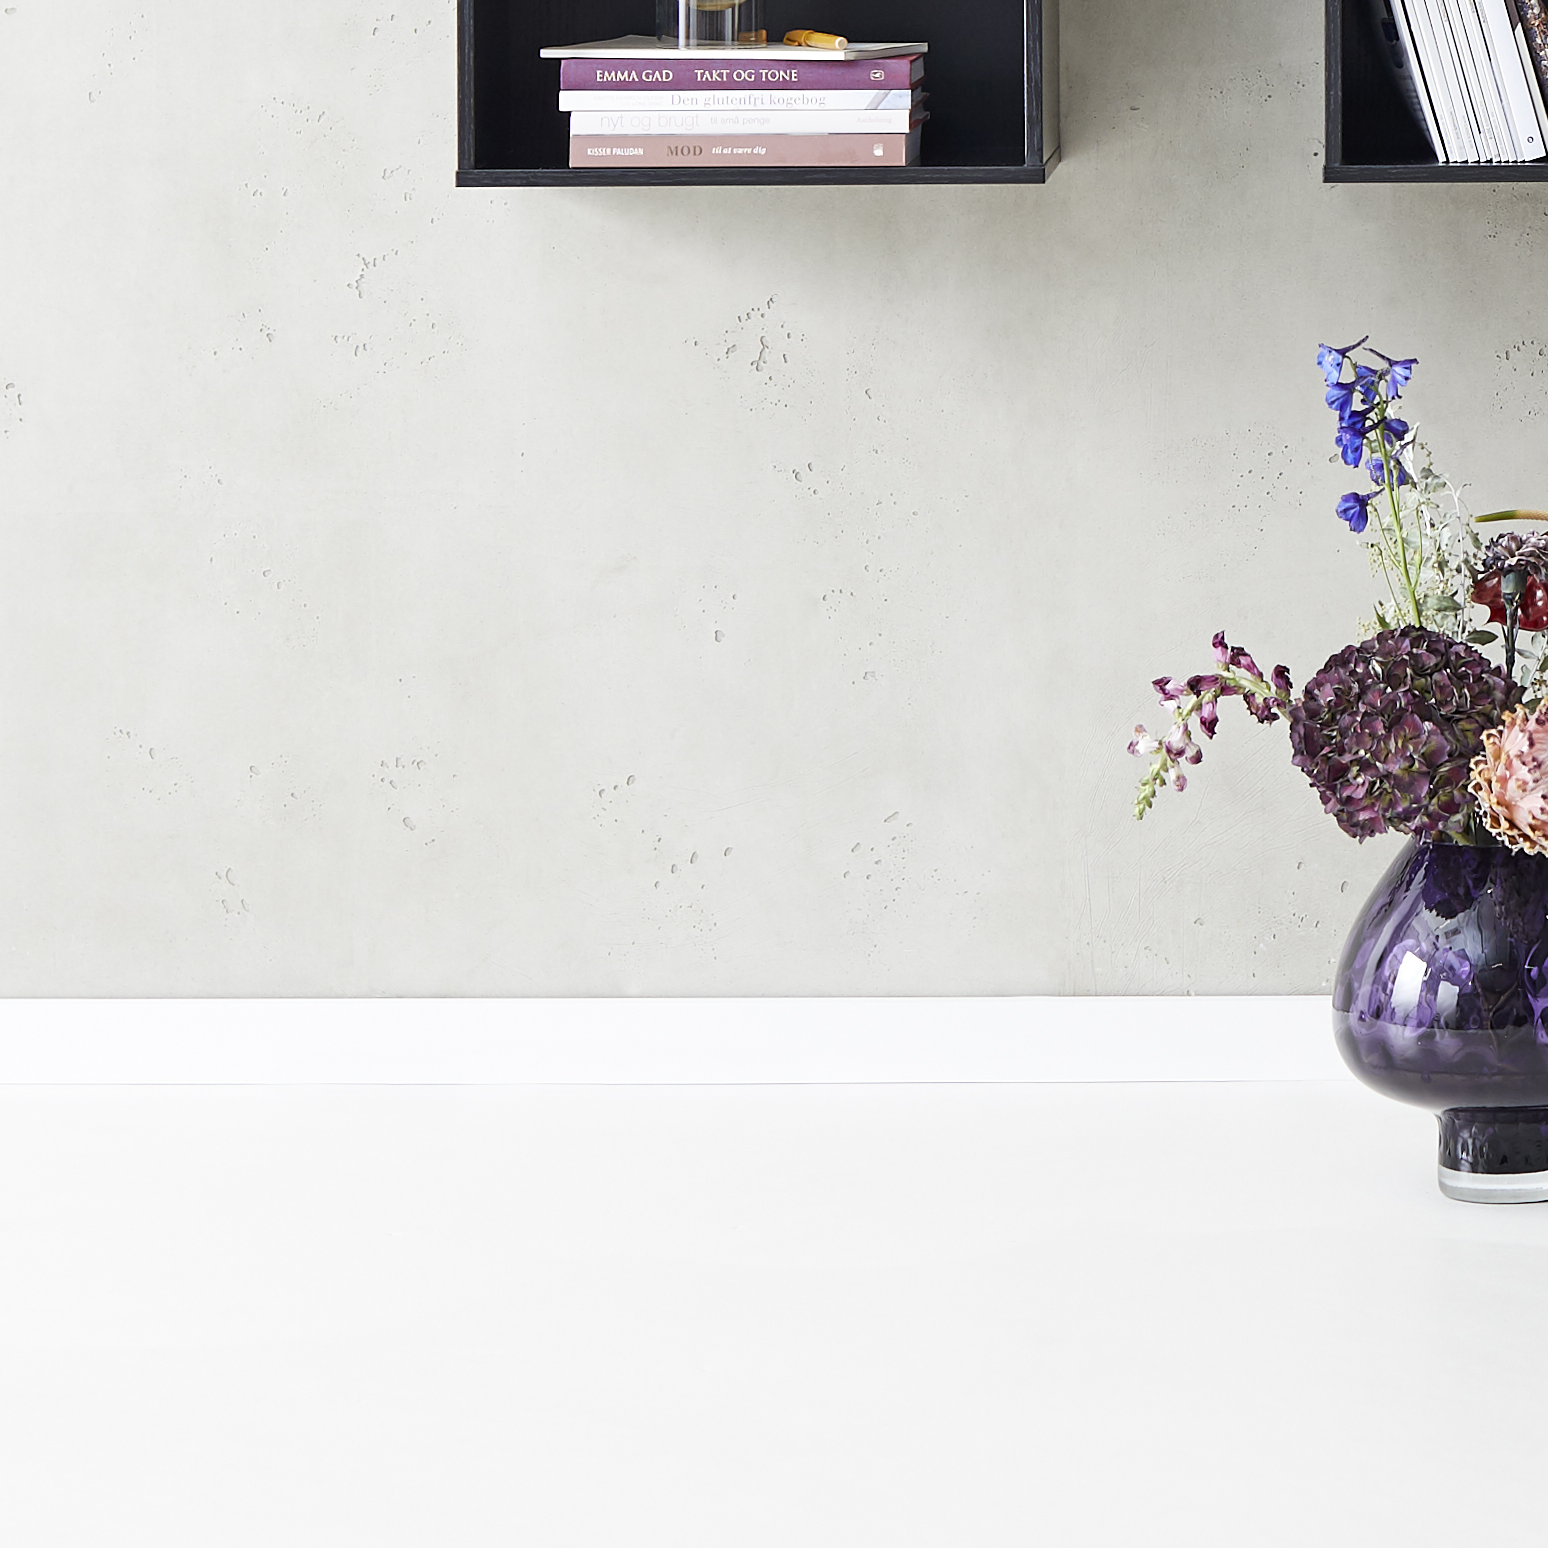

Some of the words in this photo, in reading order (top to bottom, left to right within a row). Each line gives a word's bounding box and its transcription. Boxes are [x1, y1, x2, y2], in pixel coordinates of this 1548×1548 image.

[596, 69, 639, 82] EMMA
[642, 69, 673, 82] GAD
[694, 69, 730, 82] TAKT
[733, 69, 756, 82] OG
[758, 69, 798, 82] TONE
[671, 93, 699, 106] Den
[703, 93, 765, 108] glutenfri
[769, 93, 827, 108] kogebog
[600, 113, 625, 130] nyt
[631, 115, 651, 130] og
[658, 113, 701, 130] brugt
[710, 116, 718, 124] til
[721, 115, 740, 124] små
[742, 117, 771, 126] penge
[587, 147, 611, 156] KISSER
[612, 147, 644, 156] PALUDAN
[666, 145, 704, 158] MOD
[712, 146, 722, 155] til
[733, 147, 752, 155] være
[753, 146, 767, 156] dig
